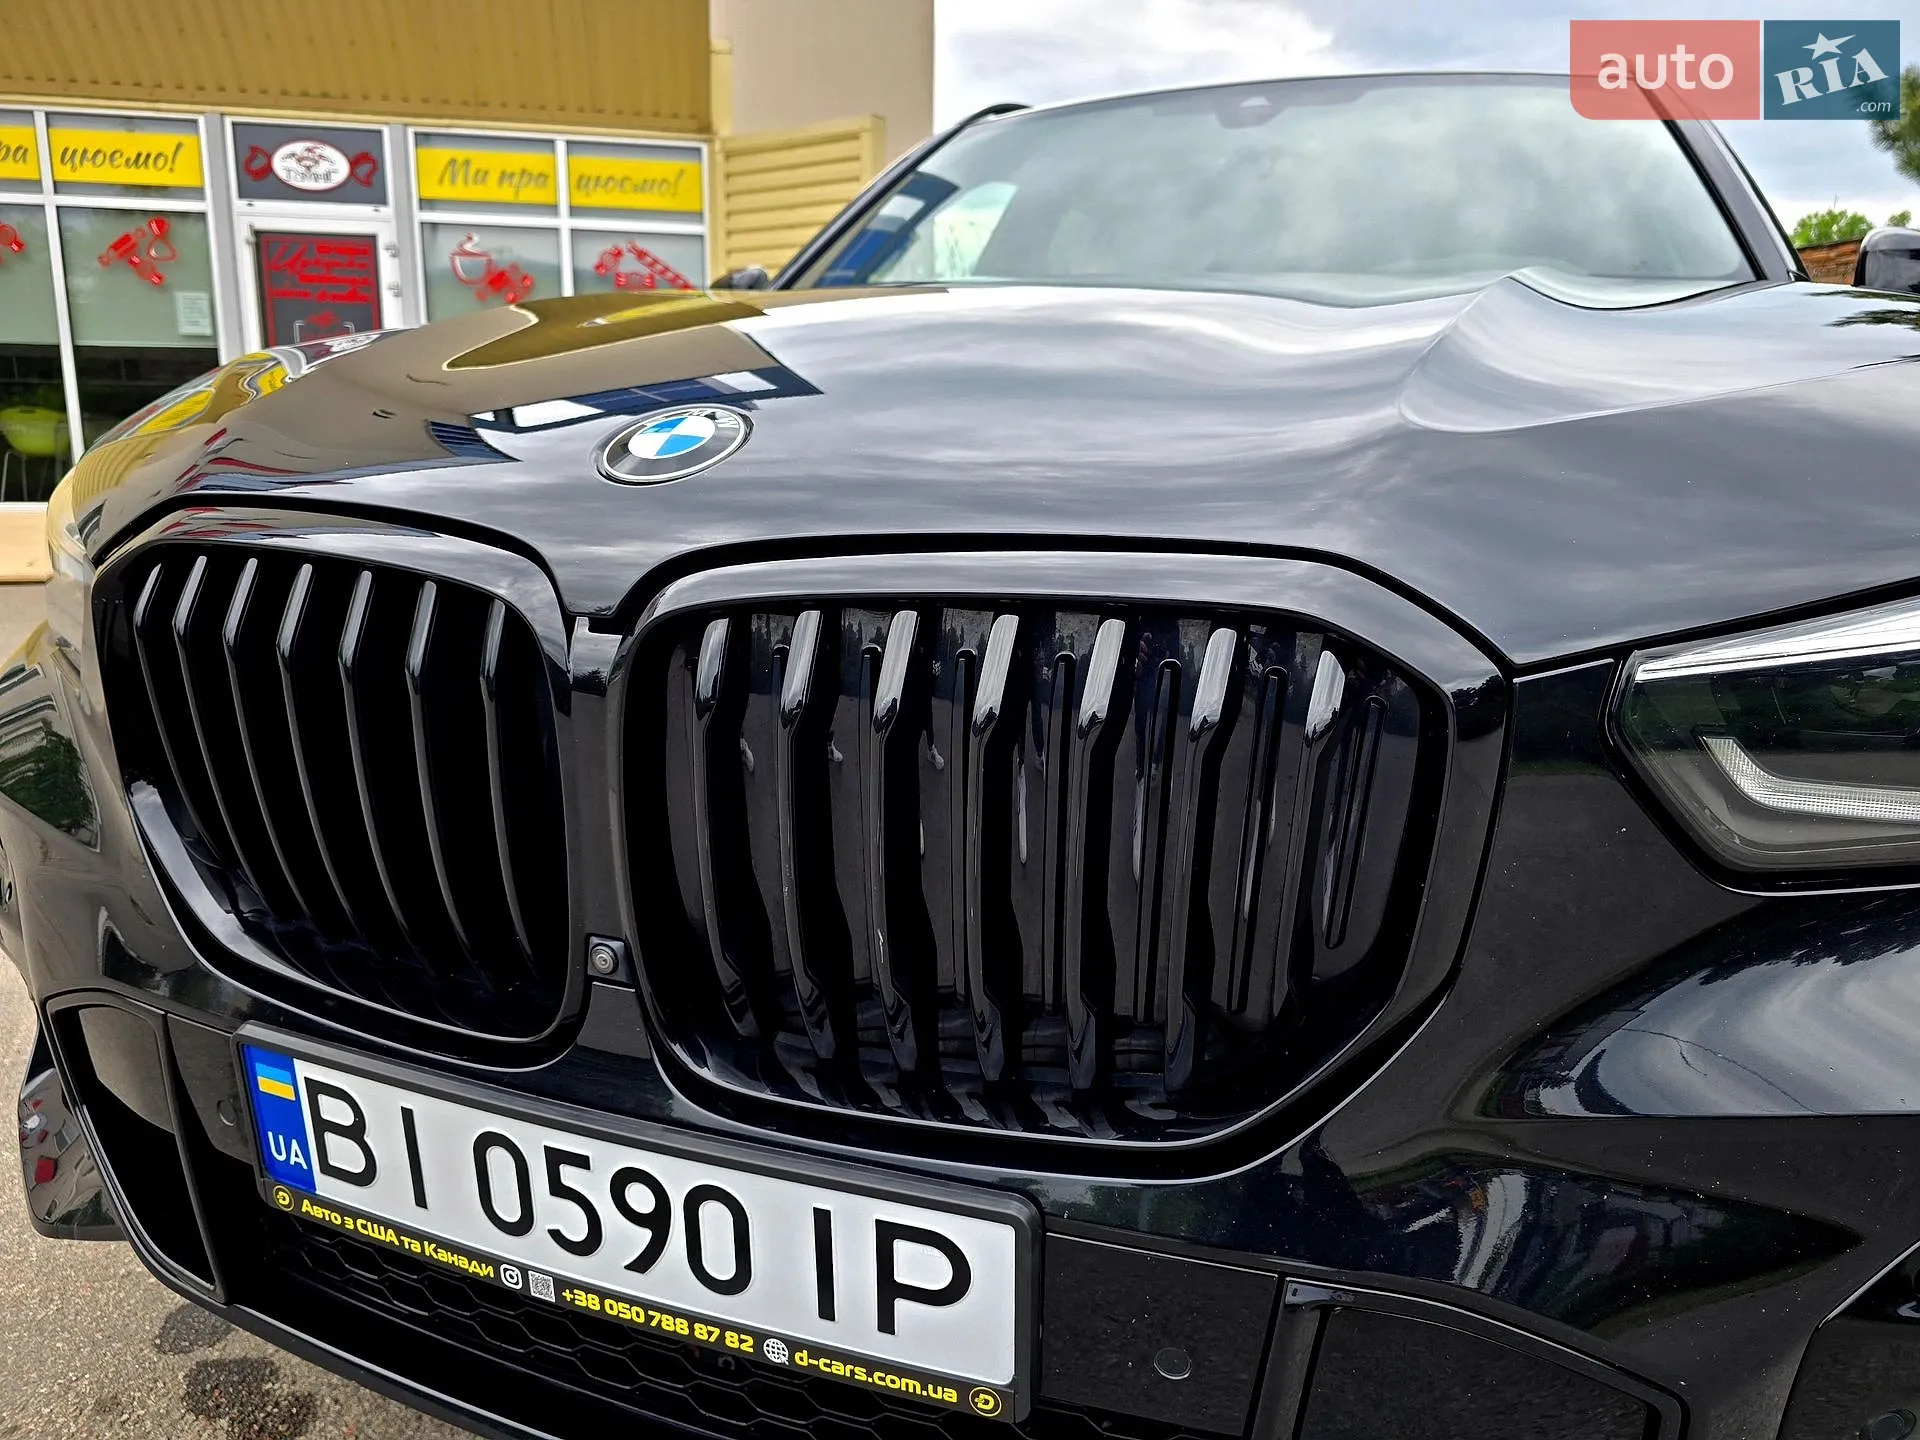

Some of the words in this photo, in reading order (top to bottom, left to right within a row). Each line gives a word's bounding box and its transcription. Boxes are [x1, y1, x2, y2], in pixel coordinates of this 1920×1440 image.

[438, 157, 490, 188] Ми
[497, 166, 550, 199] пра
[267, 1130, 308, 1171] UA
[303, 1075, 430, 1211] BI
[472, 1130, 753, 1297] 0590
[812, 1206, 973, 1337] IP
[301, 1198, 342, 1225] Авто
[344, 1216, 355, 1230] з
[356, 1218, 399, 1245] США
[400, 1236, 422, 1254] та
[424, 1243, 495, 1279] Канади
[562, 1289, 601, 1311] +38
[603, 1298, 646, 1324] 050
[648, 1310, 690, 1337] 788
[693, 1322, 721, 1343] 87
[724, 1330, 754, 1353] 82
[794, 1350, 958, 1404] d-cars.com.ua
